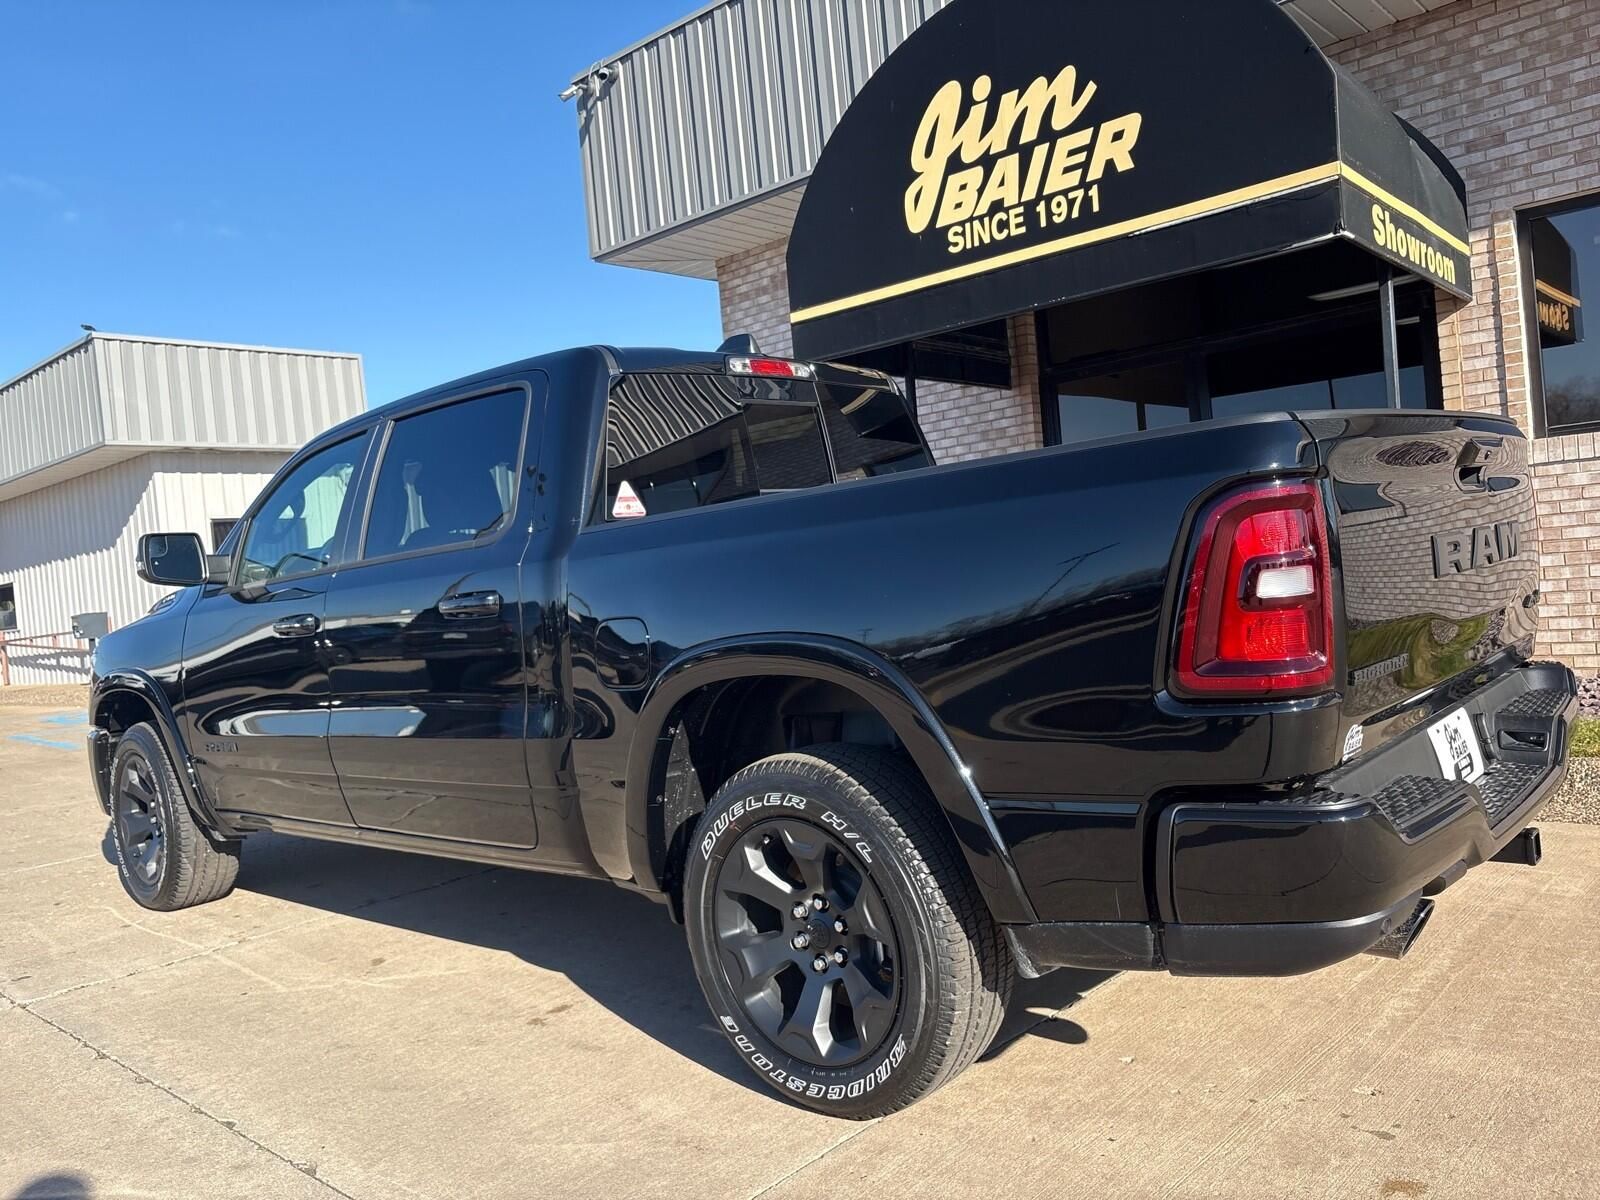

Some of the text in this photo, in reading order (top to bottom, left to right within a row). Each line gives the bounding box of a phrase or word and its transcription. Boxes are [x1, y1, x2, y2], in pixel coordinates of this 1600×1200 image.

[904, 65, 1097, 234] Jim
[935, 112, 1142, 228] BAIER
[947, 184, 1100, 254] SINCE 1971
[1371, 203, 1456, 285] Showroom
[1430, 520, 1521, 579] RAM
[701, 792, 874, 864] DUELER H/L
[719, 1013, 909, 1101] BRIDGESTONE
